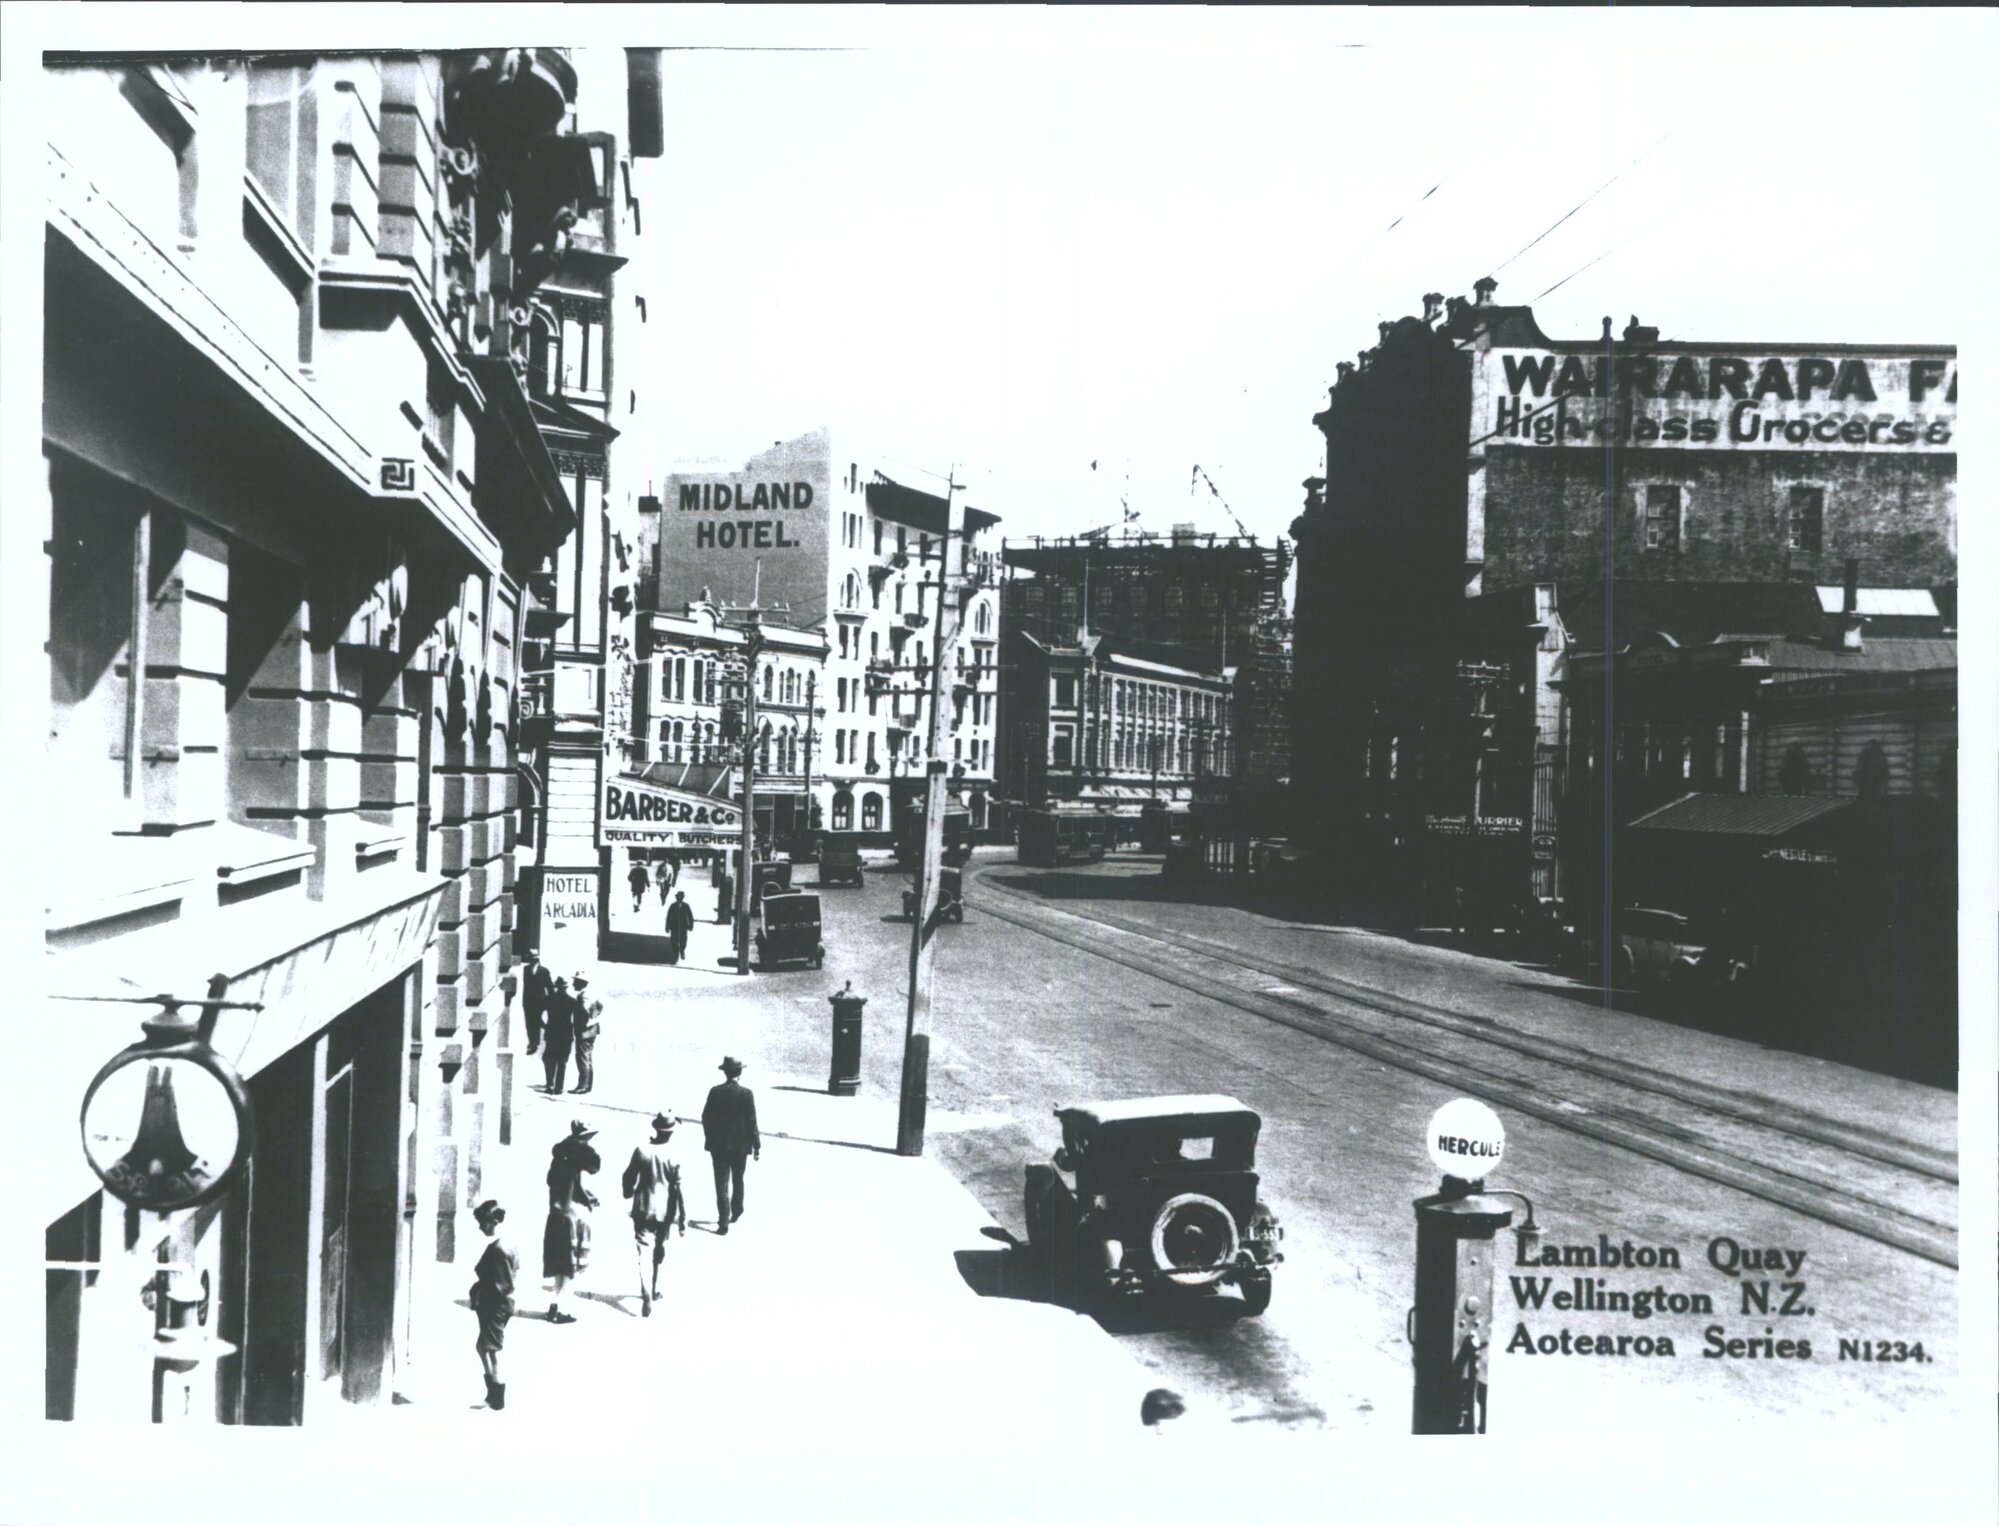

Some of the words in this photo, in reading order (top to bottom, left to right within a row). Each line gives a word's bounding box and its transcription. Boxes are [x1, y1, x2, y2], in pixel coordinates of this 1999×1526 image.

[1502, 355, 1878, 402] WAIRARAPA
[1729, 400, 1917, 445] Grocers
[1924, 420, 1953, 446] &
[679, 481, 814, 511] MIDLAND
[696, 520, 800, 549] HOTEL.
[604, 831, 670, 843] QUALITY
[678, 832, 743, 846] BUTCHERS
[546, 877, 592, 893] HOTEL
[544, 902, 596, 918] ARCADIA
